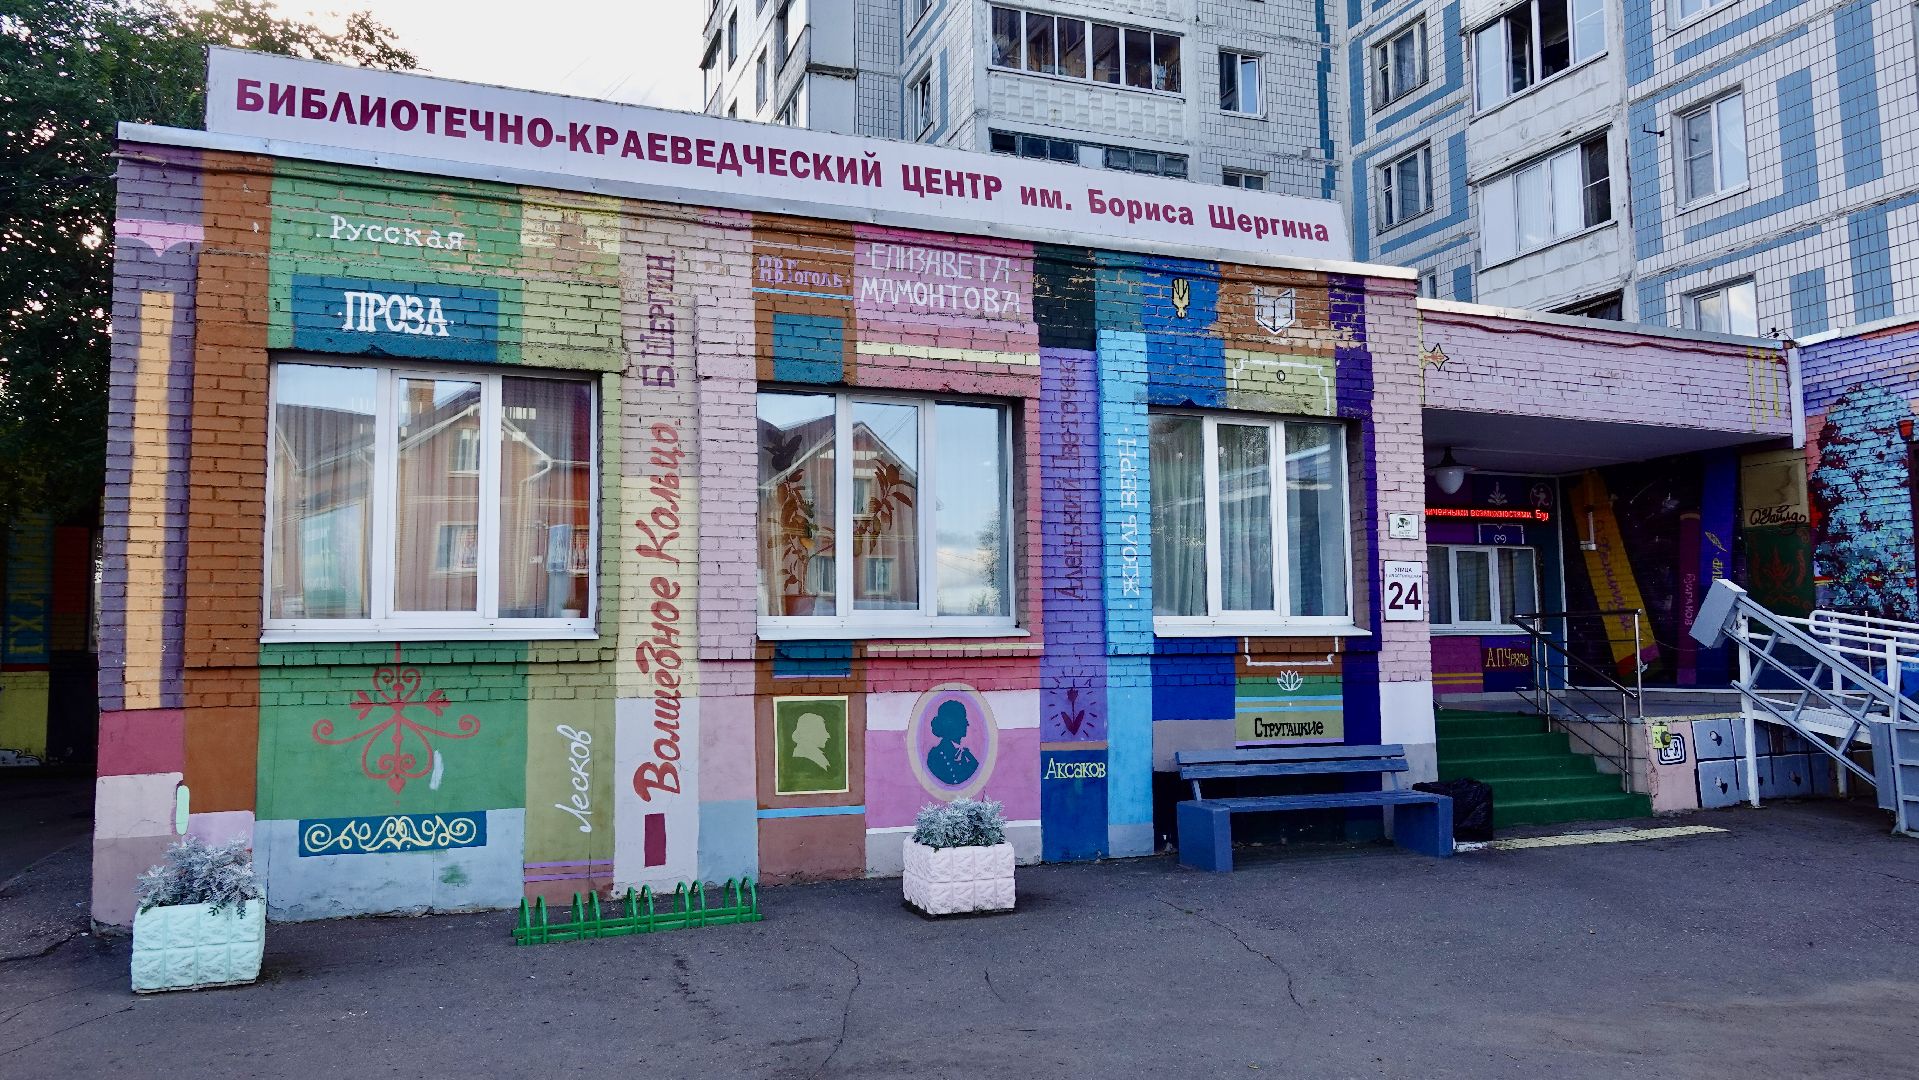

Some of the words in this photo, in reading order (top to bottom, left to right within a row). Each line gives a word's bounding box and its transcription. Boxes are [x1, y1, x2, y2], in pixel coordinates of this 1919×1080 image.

[236, 78, 882, 188] БИБЛИОТЕЧНО-КРАЕВЕДЧЕСКИЙ
[901, 164, 1003, 201] ЦЕНТР
[1020, 185, 1072, 210] им.
[1088, 188, 1194, 225] Бориса
[1208, 204, 1329, 242] Шергина
[330, 215, 465, 251] Русская
[342, 291, 450, 337] ПРОЗА
[860, 275, 1021, 316] МАМОНТОВА
[1118, 437, 1138, 509] ВЕРН
[1121, 514, 1140, 597] ЖЮЛЬ
[1389, 581, 1422, 610] 24
[633, 576, 683, 803] Волшебное
[554, 724, 593, 834] Лесков
[1043, 757, 1107, 780] Аксаков
